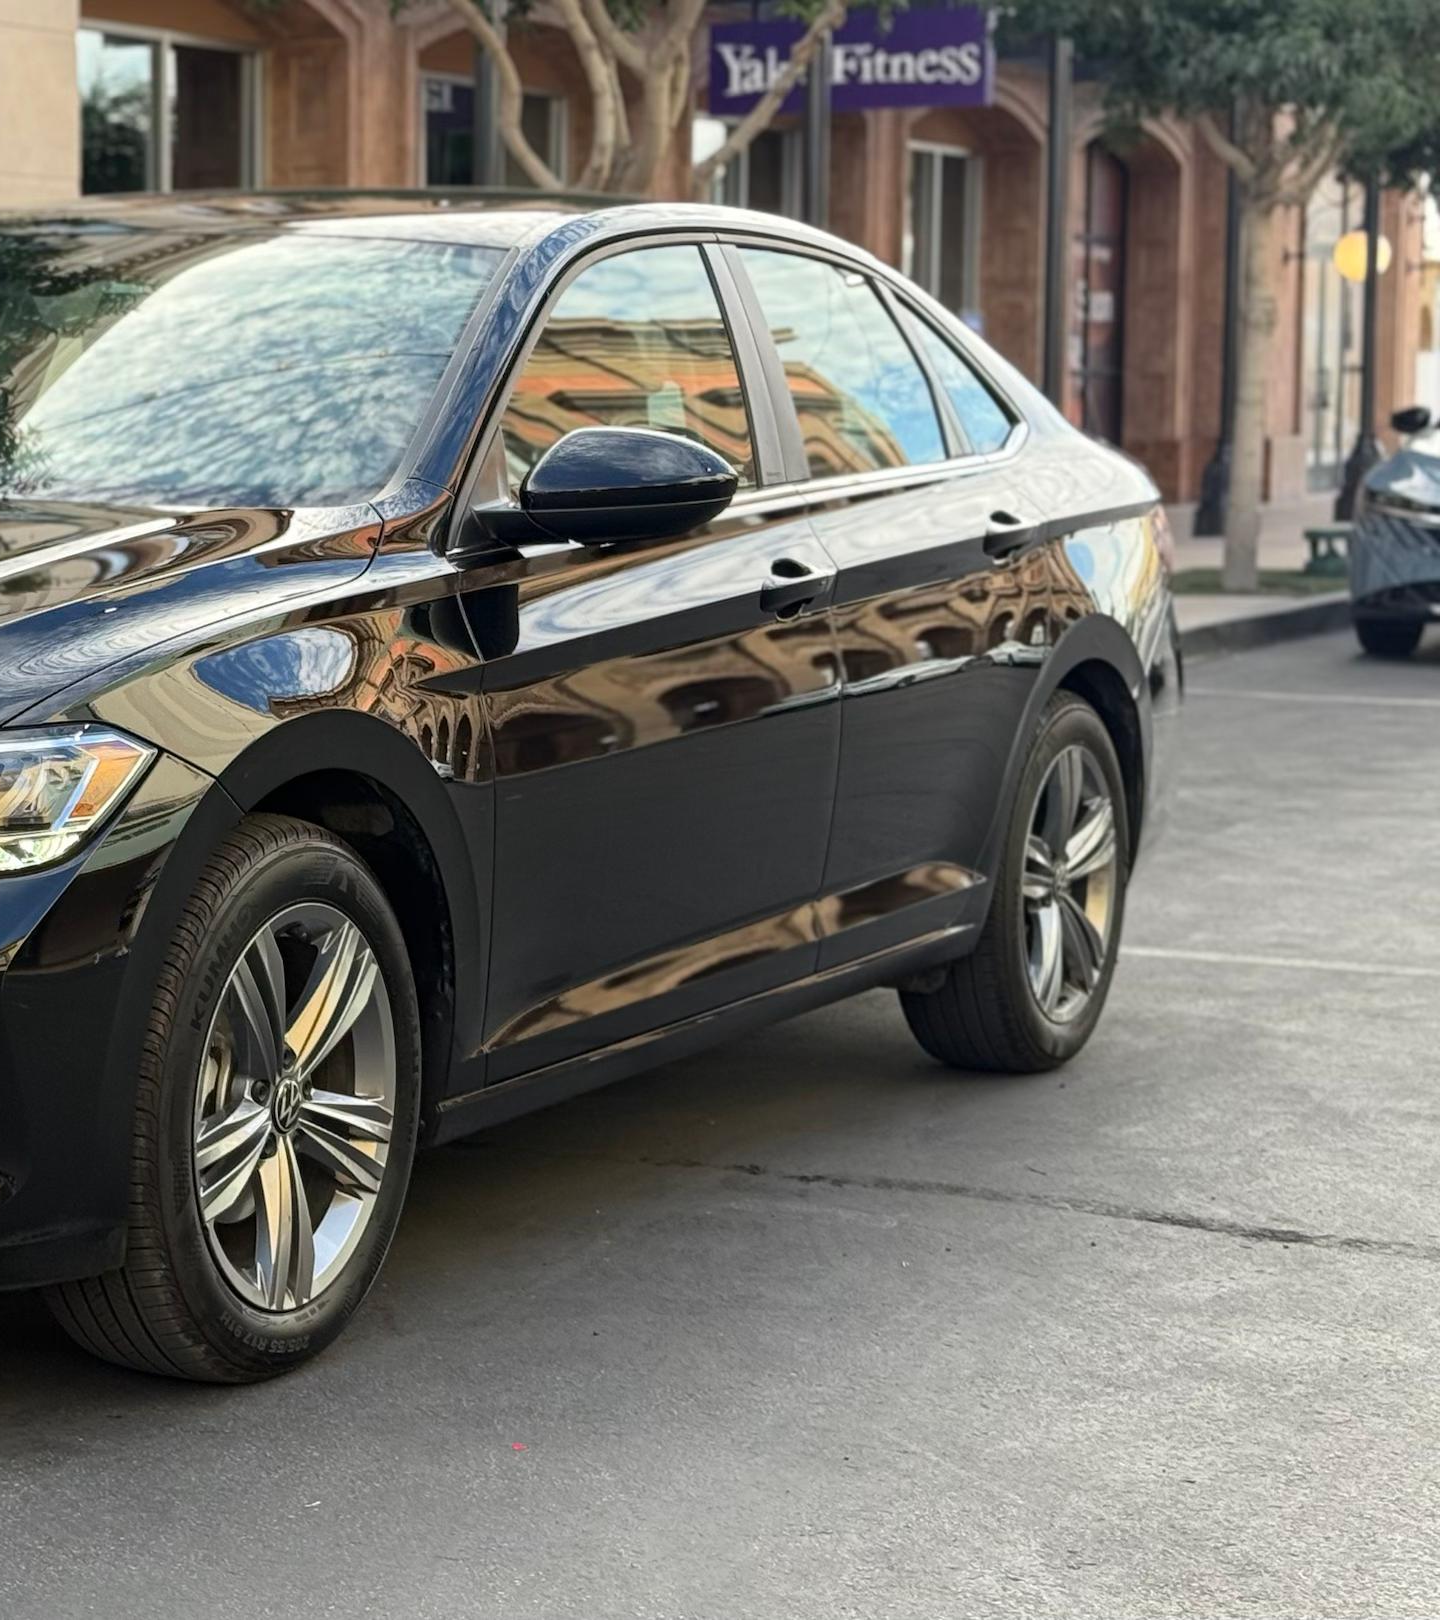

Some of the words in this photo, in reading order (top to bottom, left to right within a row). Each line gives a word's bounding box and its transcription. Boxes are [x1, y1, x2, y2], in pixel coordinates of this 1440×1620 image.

[717, 43, 807, 97] Yak
[831, 43, 982, 86] Fitness
[190, 902, 258, 1031] KUMHO
[243, 1332, 267, 1352] R17
